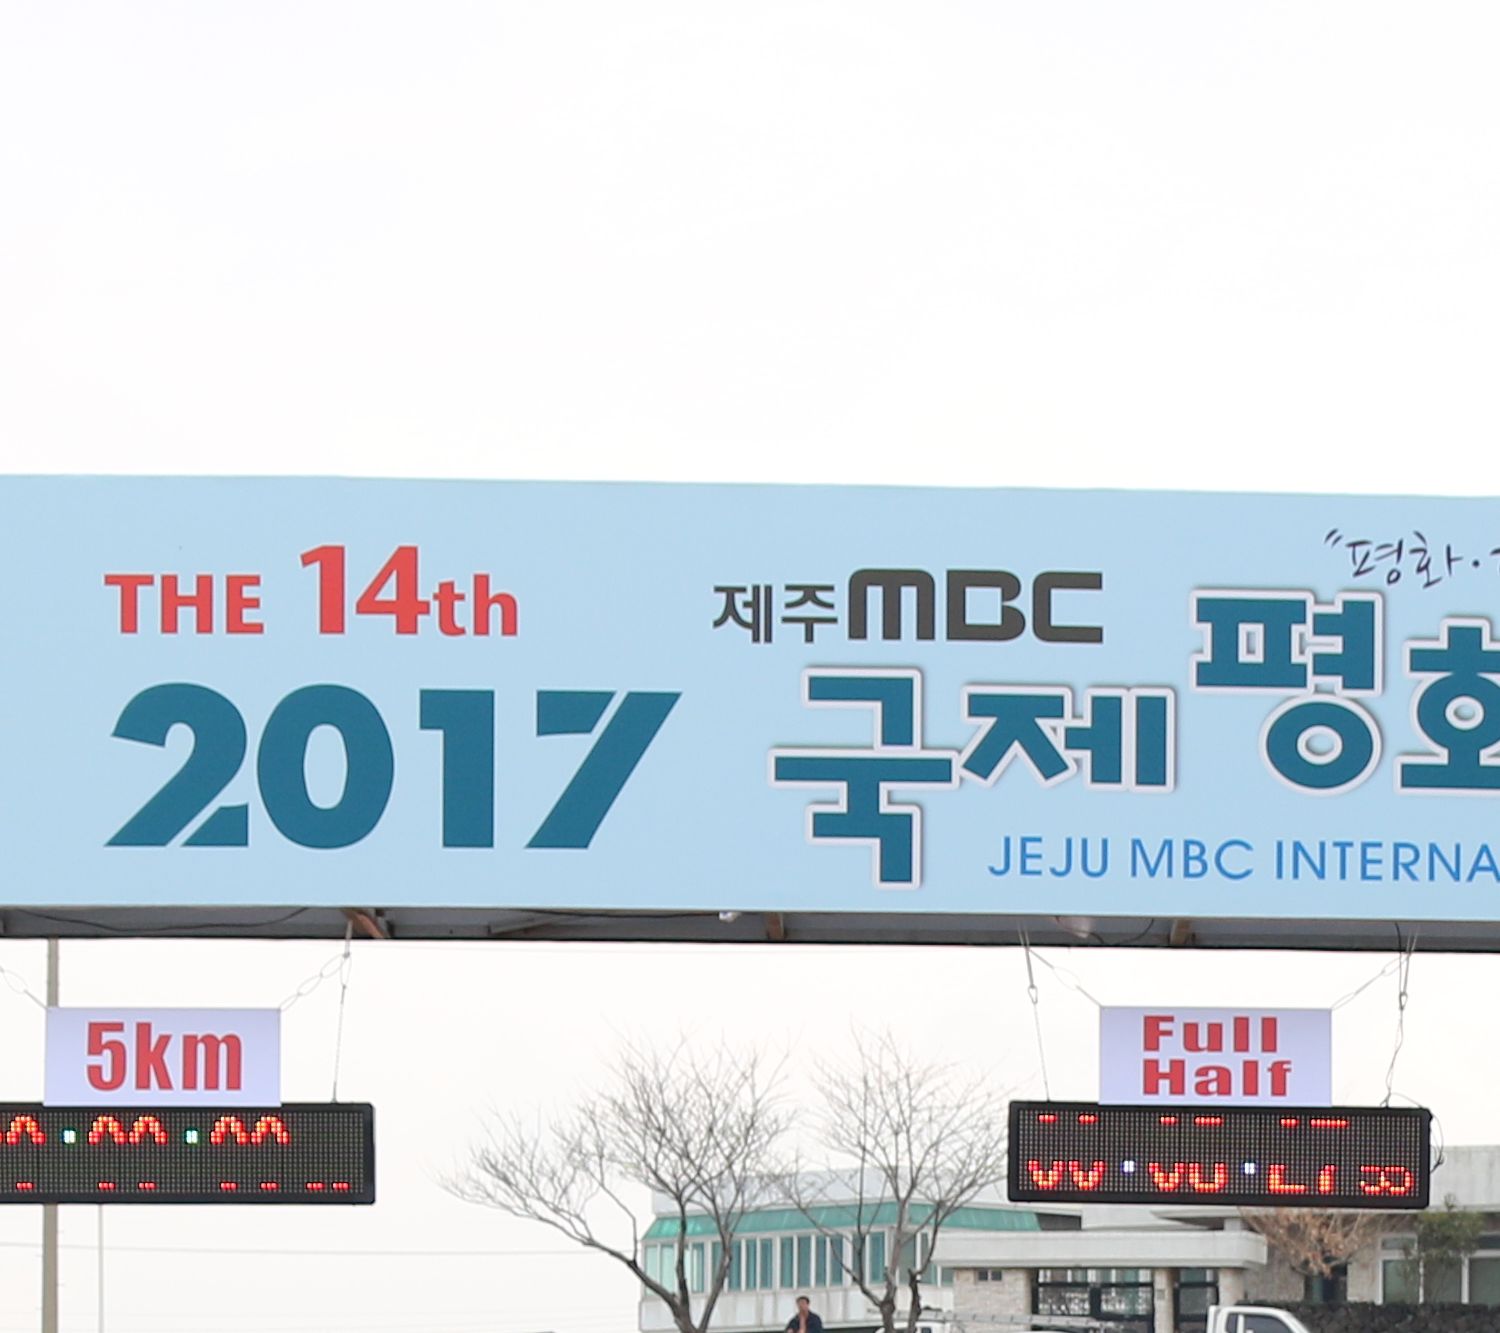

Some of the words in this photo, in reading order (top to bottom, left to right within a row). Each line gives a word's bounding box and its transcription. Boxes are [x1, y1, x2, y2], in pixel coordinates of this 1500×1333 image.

[102, 573, 265, 635] THE
[299, 544, 519, 637] 14th
[711, 567, 1104, 644] 제주MBC
[102, 681, 684, 850] 2017
[986, 834, 1111, 880] JEJU
[1129, 836, 1255, 882] MBC
[86, 1021, 243, 1092] 5km
[1142, 1014, 1279, 1054] Full
[1142, 1058, 1293, 1097] Half
